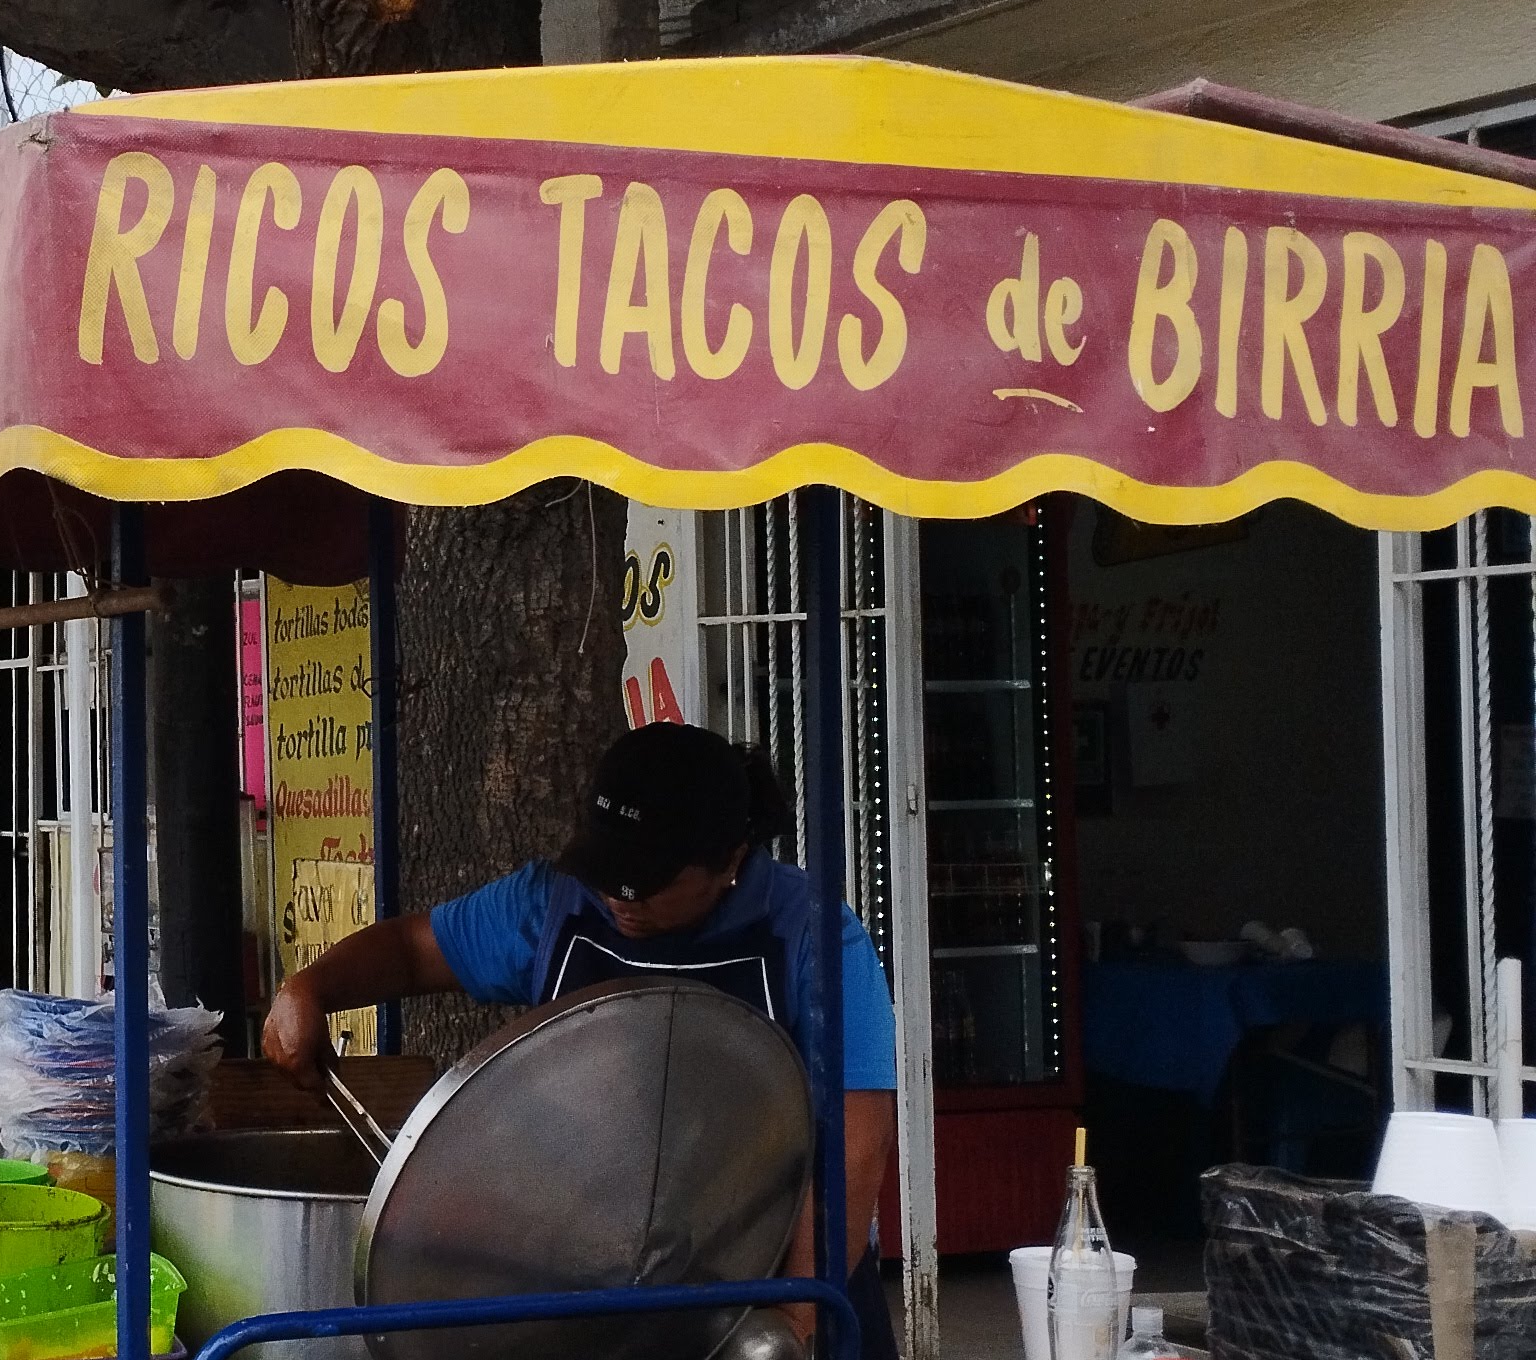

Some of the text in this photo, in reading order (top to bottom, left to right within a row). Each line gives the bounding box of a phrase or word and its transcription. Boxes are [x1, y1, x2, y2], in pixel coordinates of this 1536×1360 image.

[77, 152, 1526, 439] RICOS TACOS de BIRRIA
[274, 605, 329, 644] tortillas
[272, 659, 343, 701] tortillas
[1078, 646, 1205, 682] EVENTOS
[276, 714, 347, 761] tortilla
